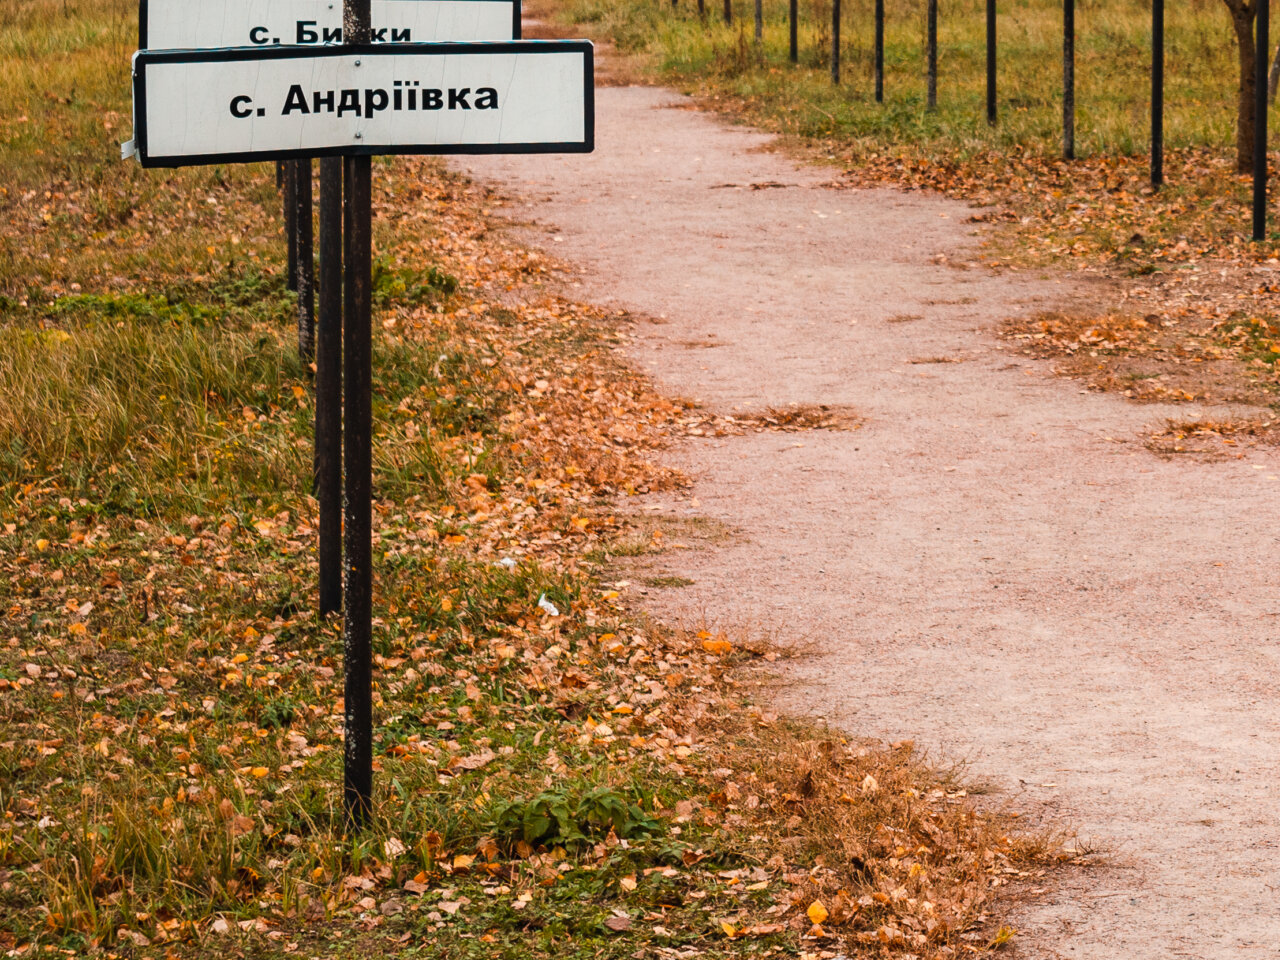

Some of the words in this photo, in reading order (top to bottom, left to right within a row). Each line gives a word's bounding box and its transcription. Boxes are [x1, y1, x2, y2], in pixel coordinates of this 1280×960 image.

[249, 25, 280, 44] с.
[296, 20, 411, 44] Бики
[229, 94, 266, 119] с.
[281, 80, 499, 119] Андріївка
